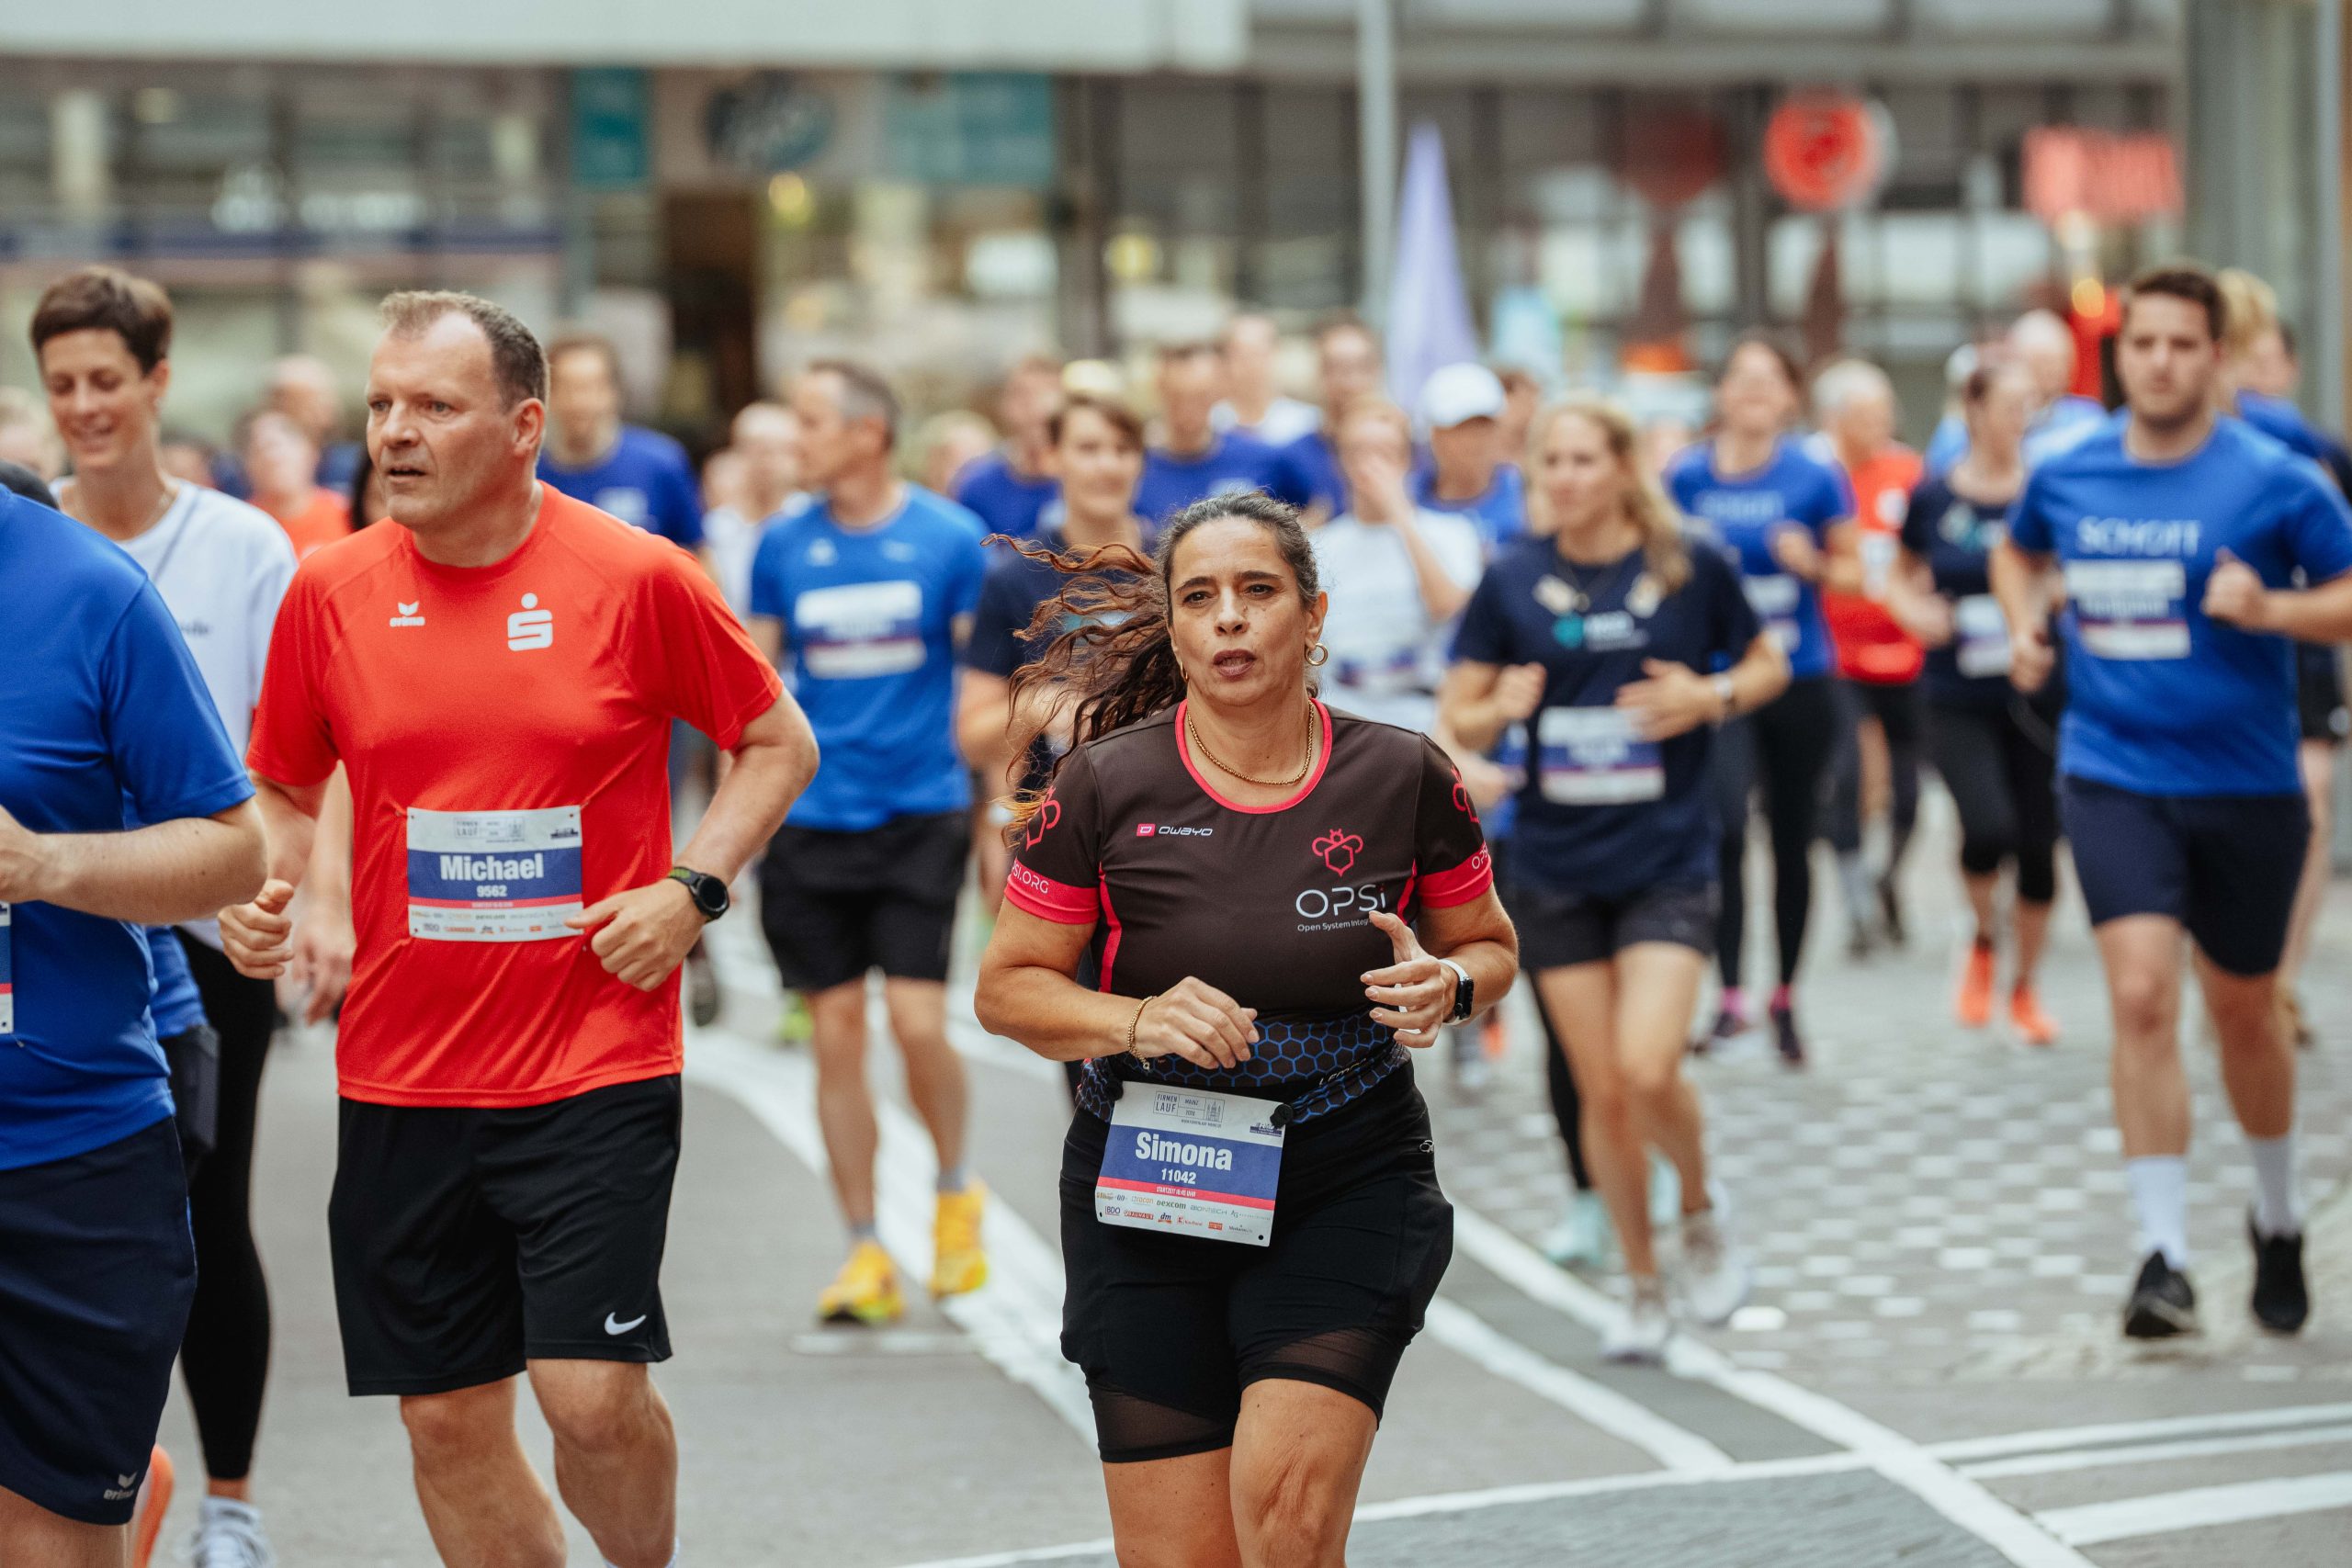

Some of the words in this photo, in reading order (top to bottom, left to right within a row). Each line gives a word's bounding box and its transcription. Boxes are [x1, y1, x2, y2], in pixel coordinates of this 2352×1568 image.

[440, 852, 544, 881] Michael
[476, 885, 508, 897] 9562
[1297, 924, 1321, 932] Open
[1322, 920, 1351, 931] System
[1156, 1102, 1177, 1113] LAUF
[1135, 1132, 1233, 1171] Simona
[1161, 1168, 1196, 1185] 11042
[1159, 1212, 1172, 1221] dm
